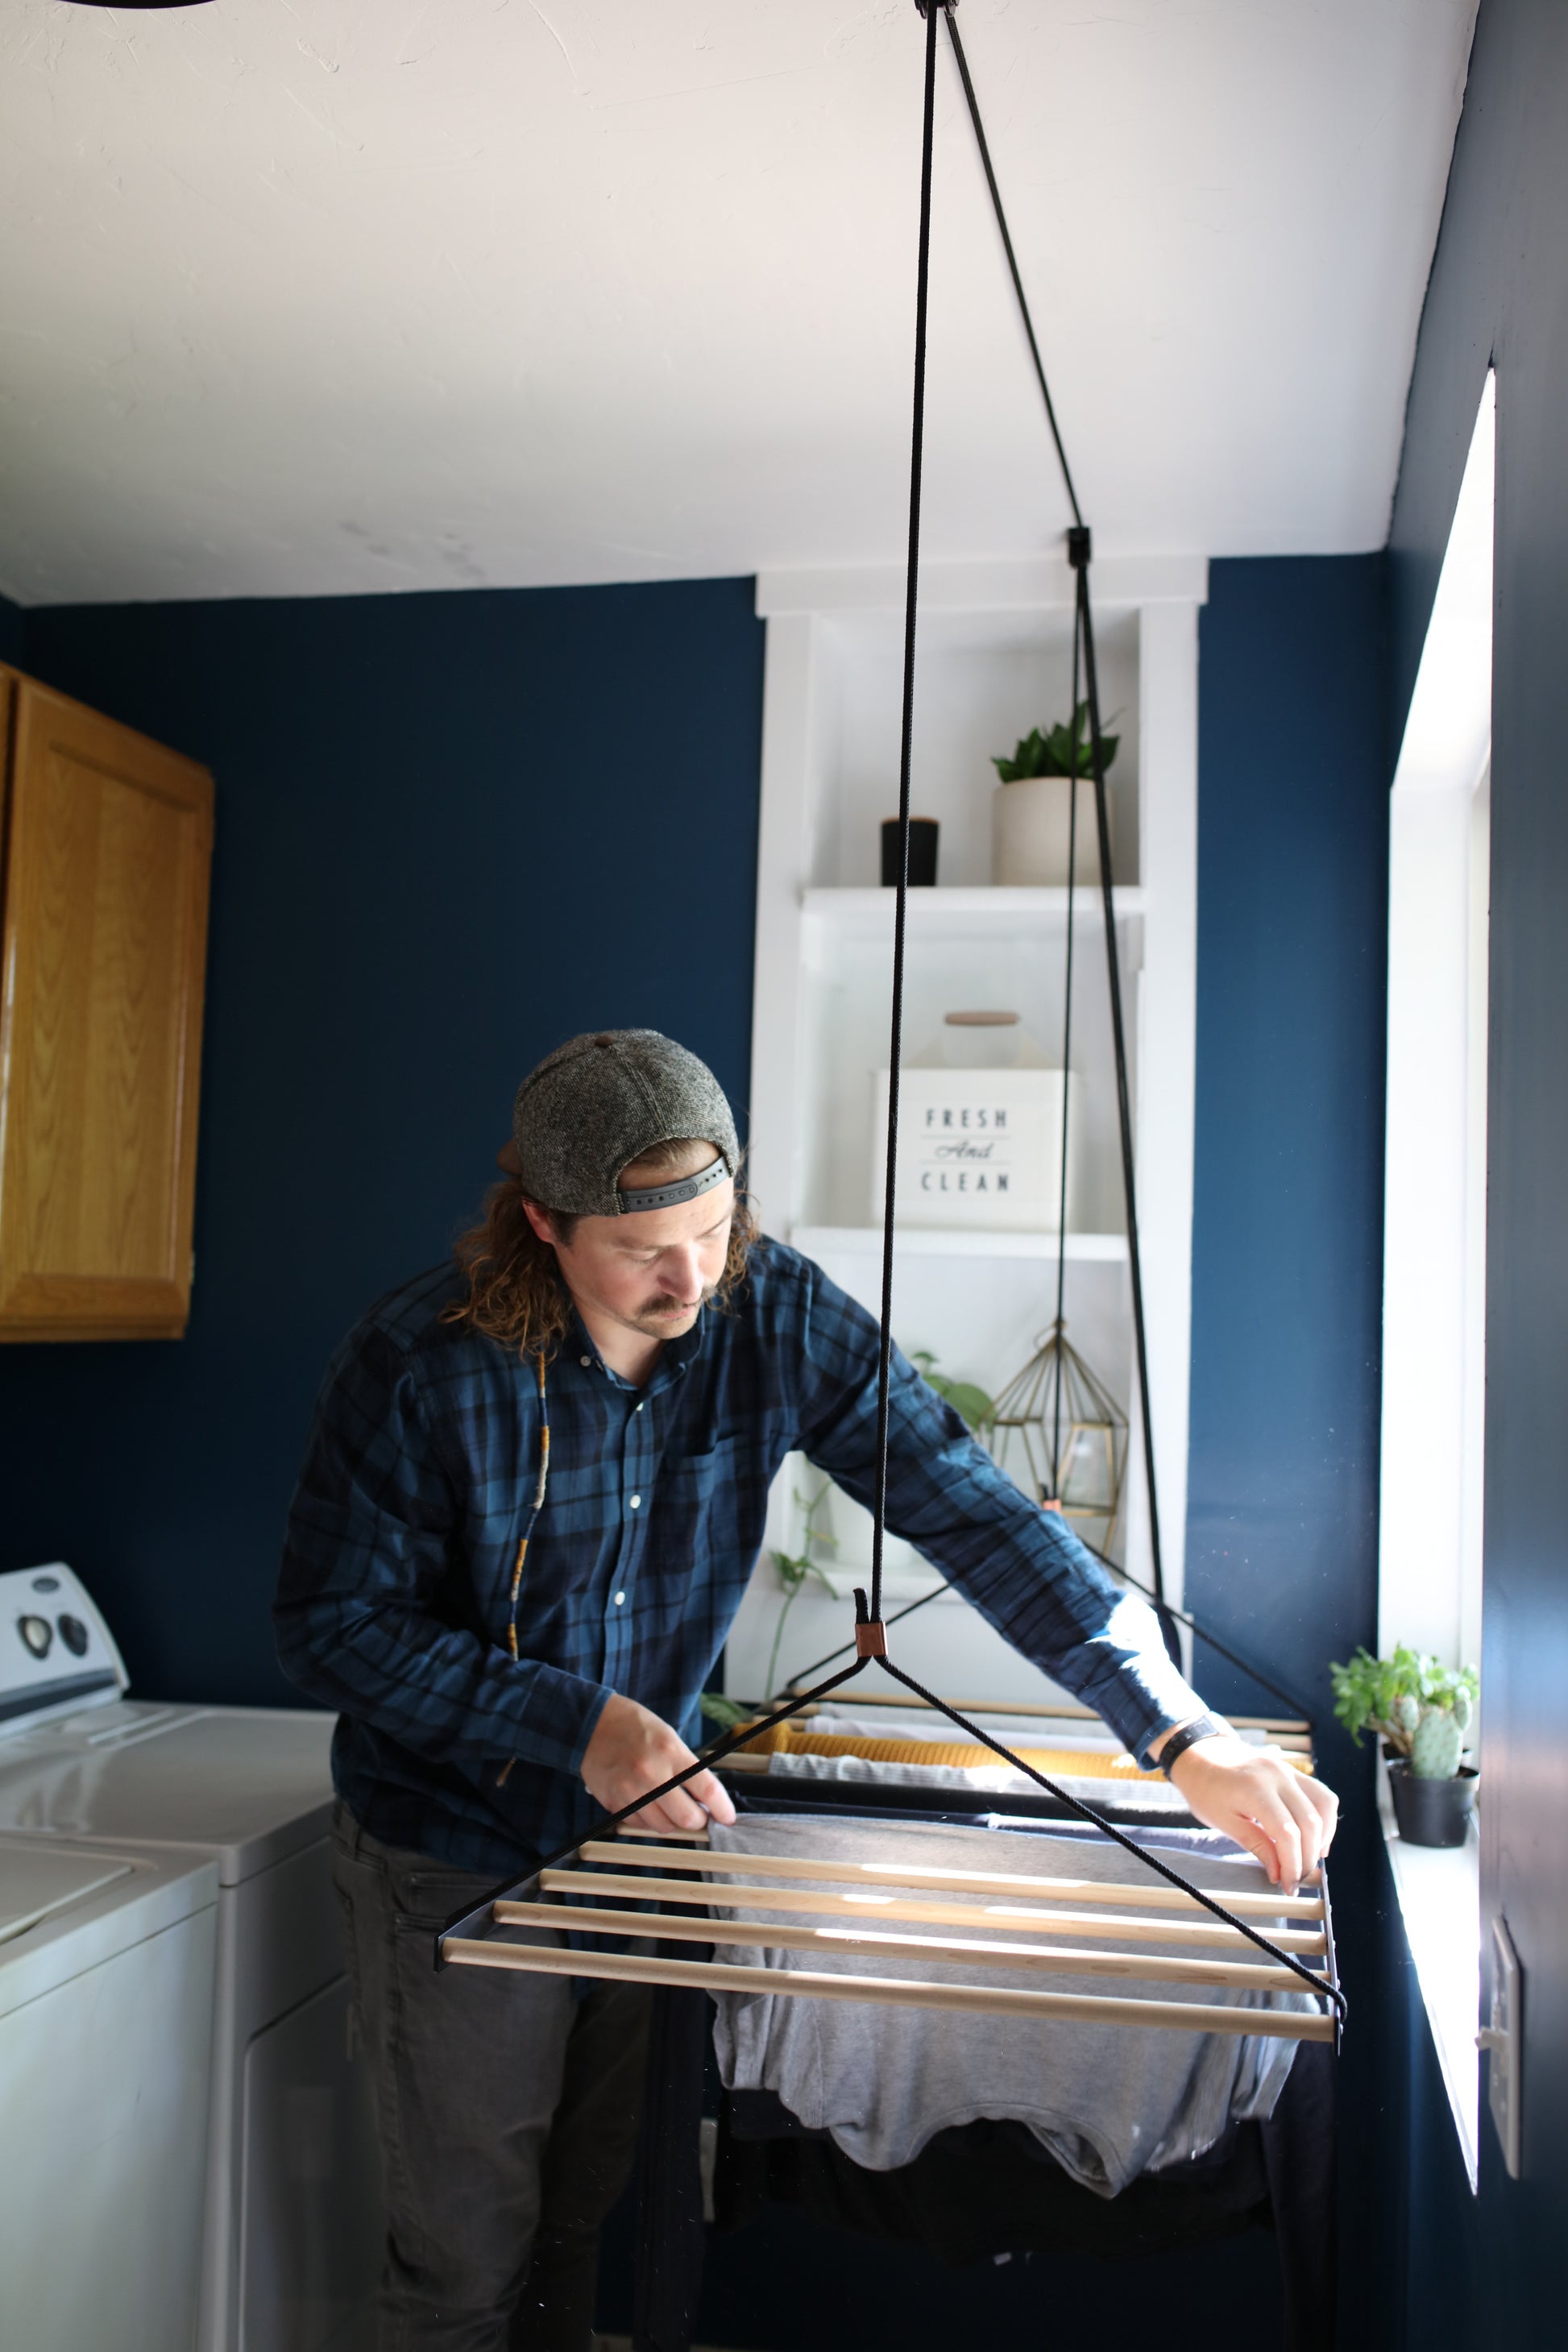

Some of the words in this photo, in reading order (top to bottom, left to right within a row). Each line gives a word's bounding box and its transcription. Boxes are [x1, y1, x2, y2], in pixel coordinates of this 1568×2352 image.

[927, 1109, 1006, 1127] FRESH
[936, 1139, 993, 1159] And
[922, 1172, 1008, 1192] CLEAN
